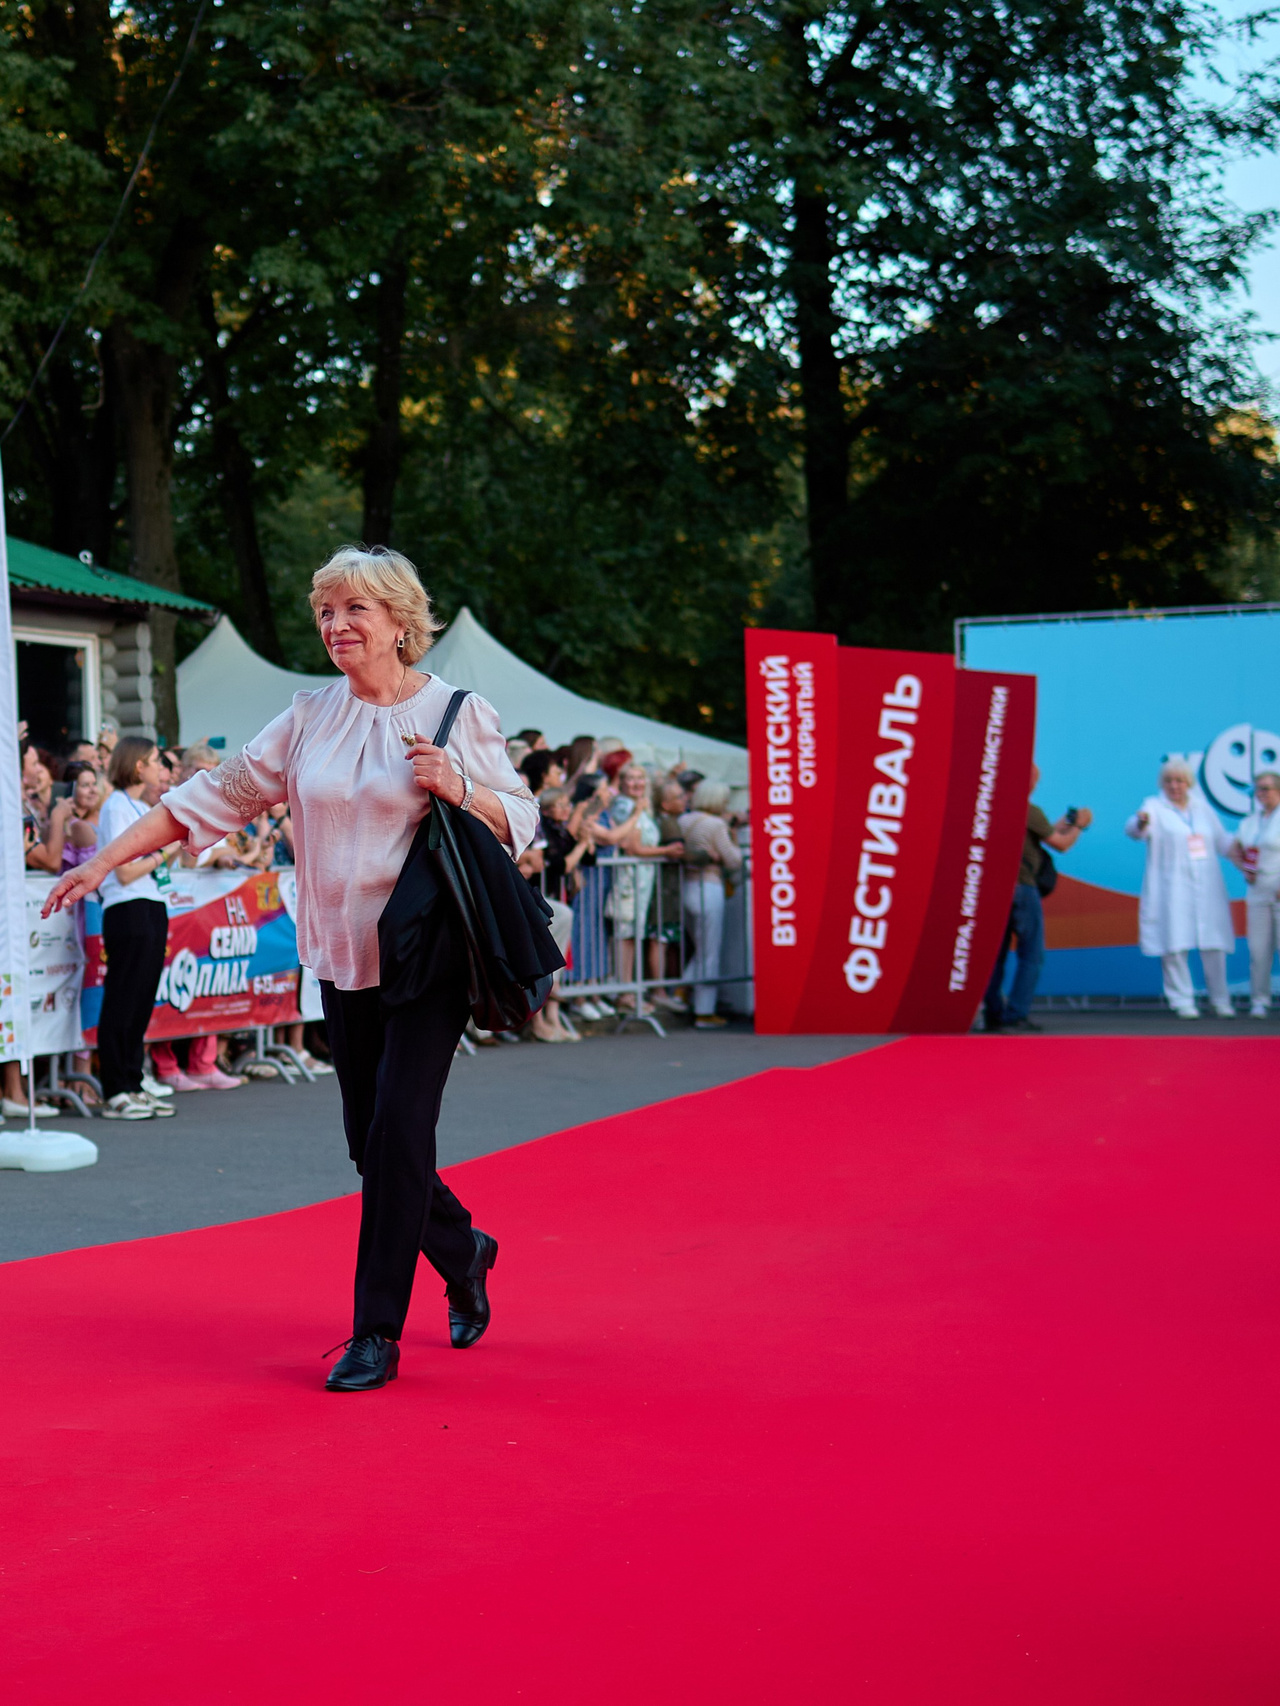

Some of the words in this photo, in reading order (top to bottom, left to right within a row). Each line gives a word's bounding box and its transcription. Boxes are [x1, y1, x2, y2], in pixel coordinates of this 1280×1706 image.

[759, 655, 793, 806] ВЯТСКИЙ
[791, 661, 817, 788] ОТКРЫТЫЙ
[972, 685, 1010, 841] ЖУРНАЛИСТИКИ
[763, 813, 797, 947] ВТОРОЙ
[842, 674, 923, 994] ФЕСТИВАЛЬ
[969, 845, 986, 863] И
[225, 895, 249, 925] НА
[961, 863, 983, 917] КИНО
[210, 925, 258, 960] СЕМИ
[949, 918, 976, 993] ТЕАТРА,
